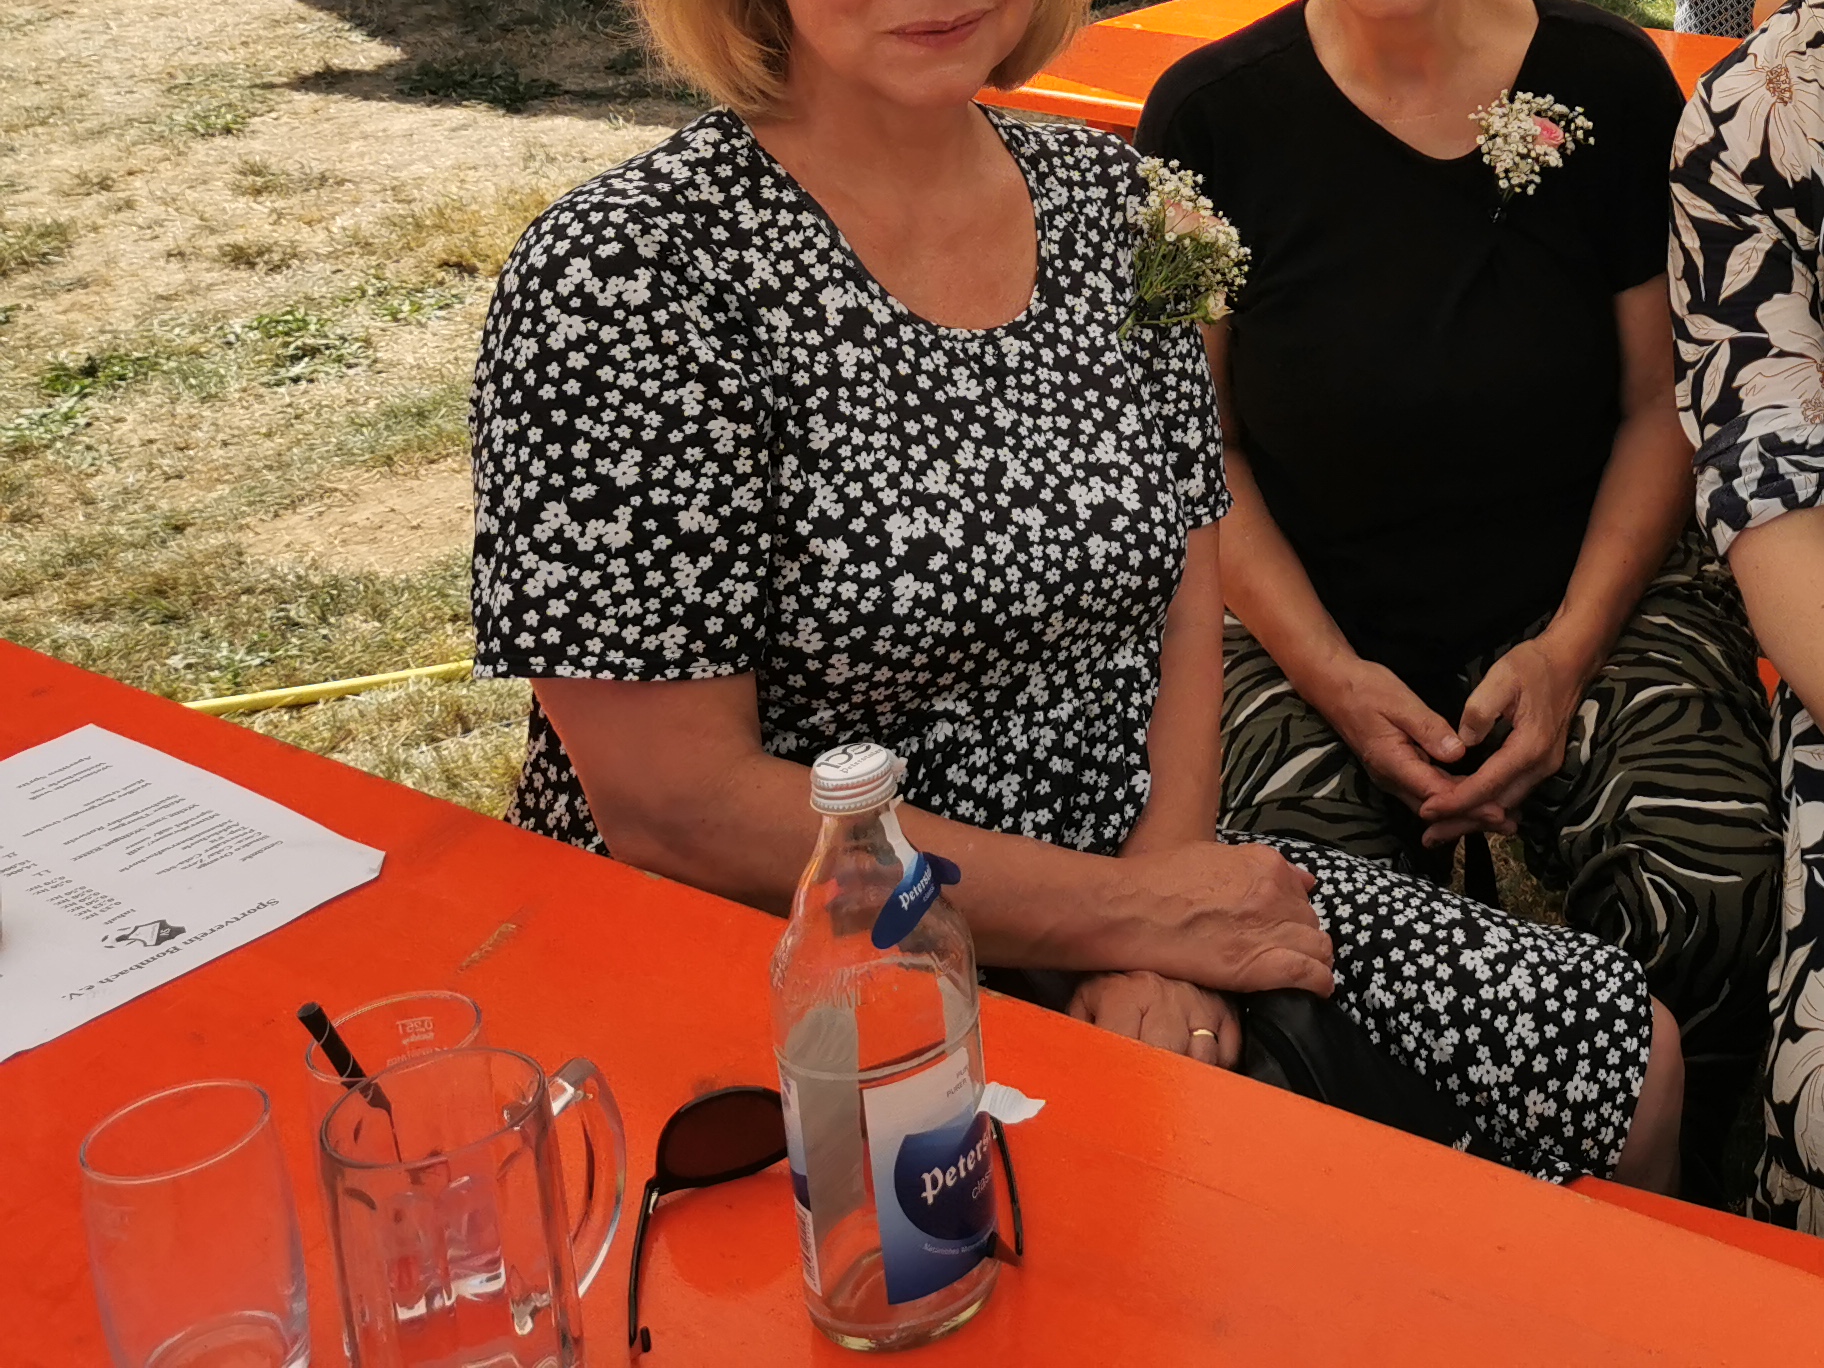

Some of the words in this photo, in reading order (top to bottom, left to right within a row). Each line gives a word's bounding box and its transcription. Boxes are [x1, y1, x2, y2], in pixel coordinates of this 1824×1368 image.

[179, 897, 281, 946] Sportverein
[96, 945, 183, 985] Bombach
[59, 984, 98, 1001] e.V.
